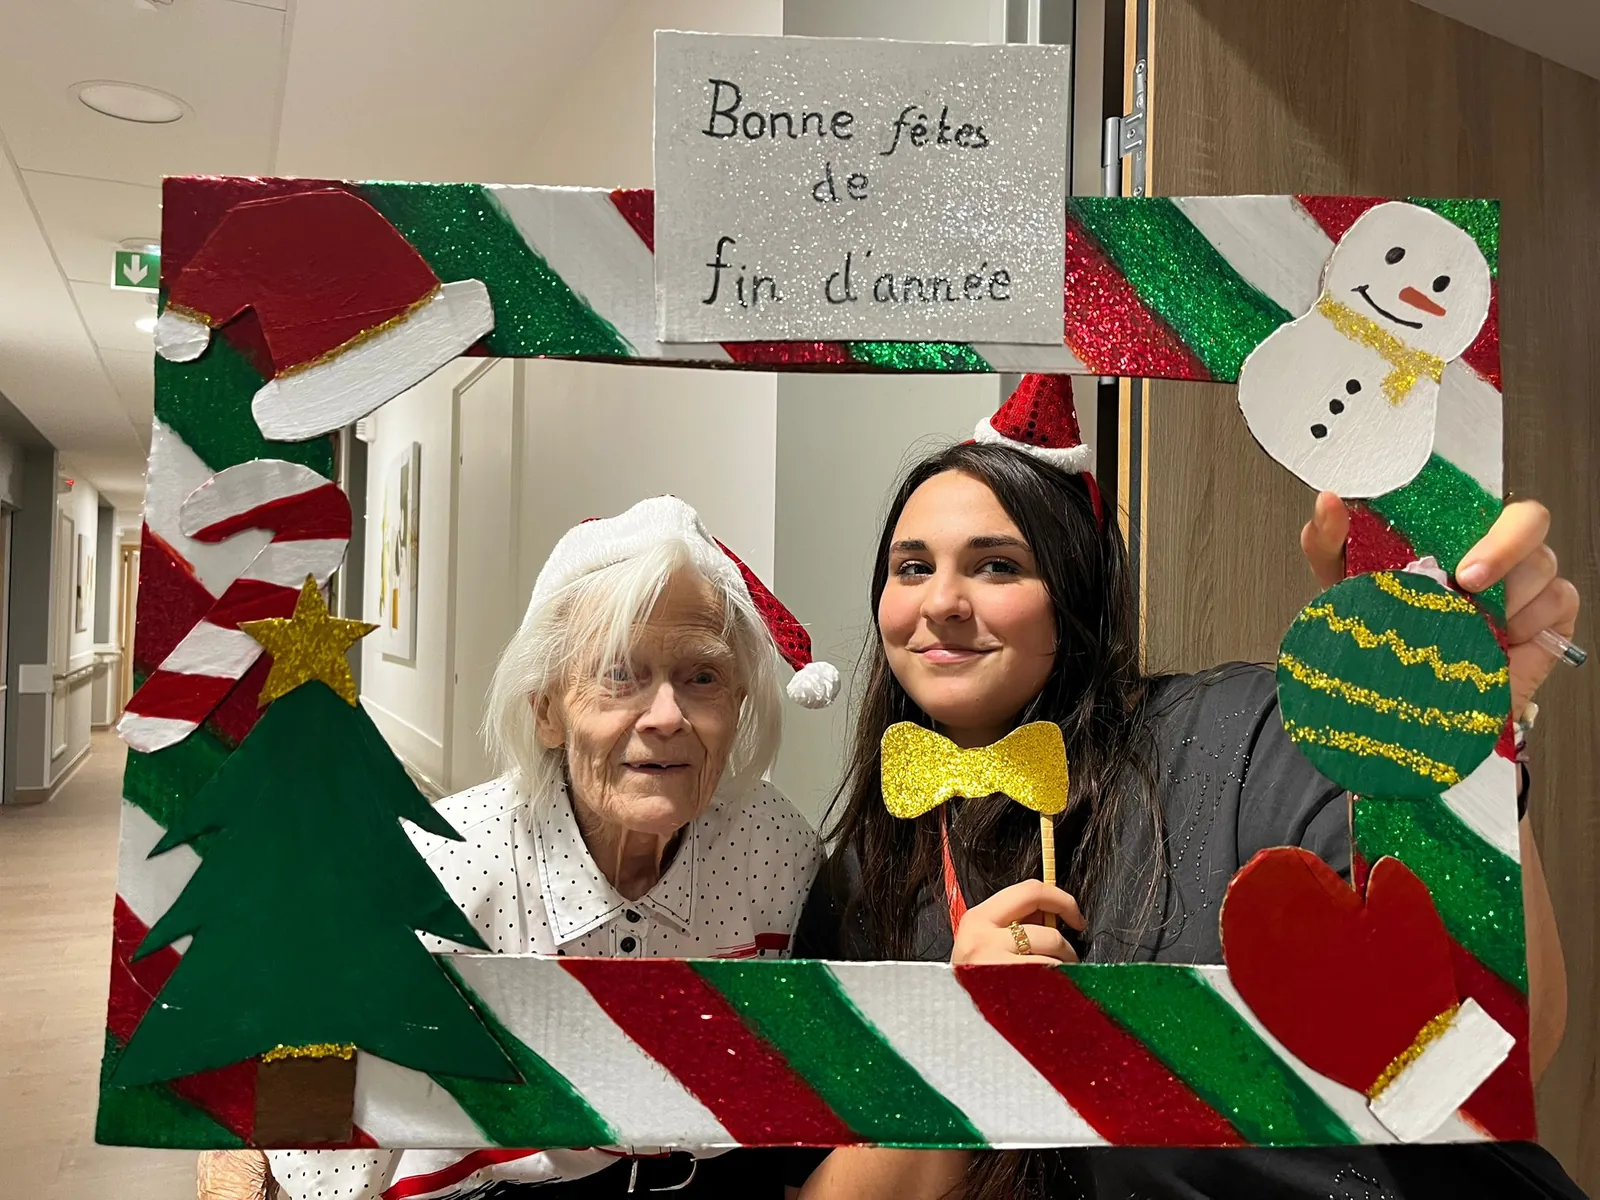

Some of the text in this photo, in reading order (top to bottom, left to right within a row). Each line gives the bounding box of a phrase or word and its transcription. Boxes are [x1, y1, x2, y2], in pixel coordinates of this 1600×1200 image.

[702, 78, 854, 140] Bonne
[812, 161, 869, 202] de
[703, 236, 1012, 308] fin d'année
